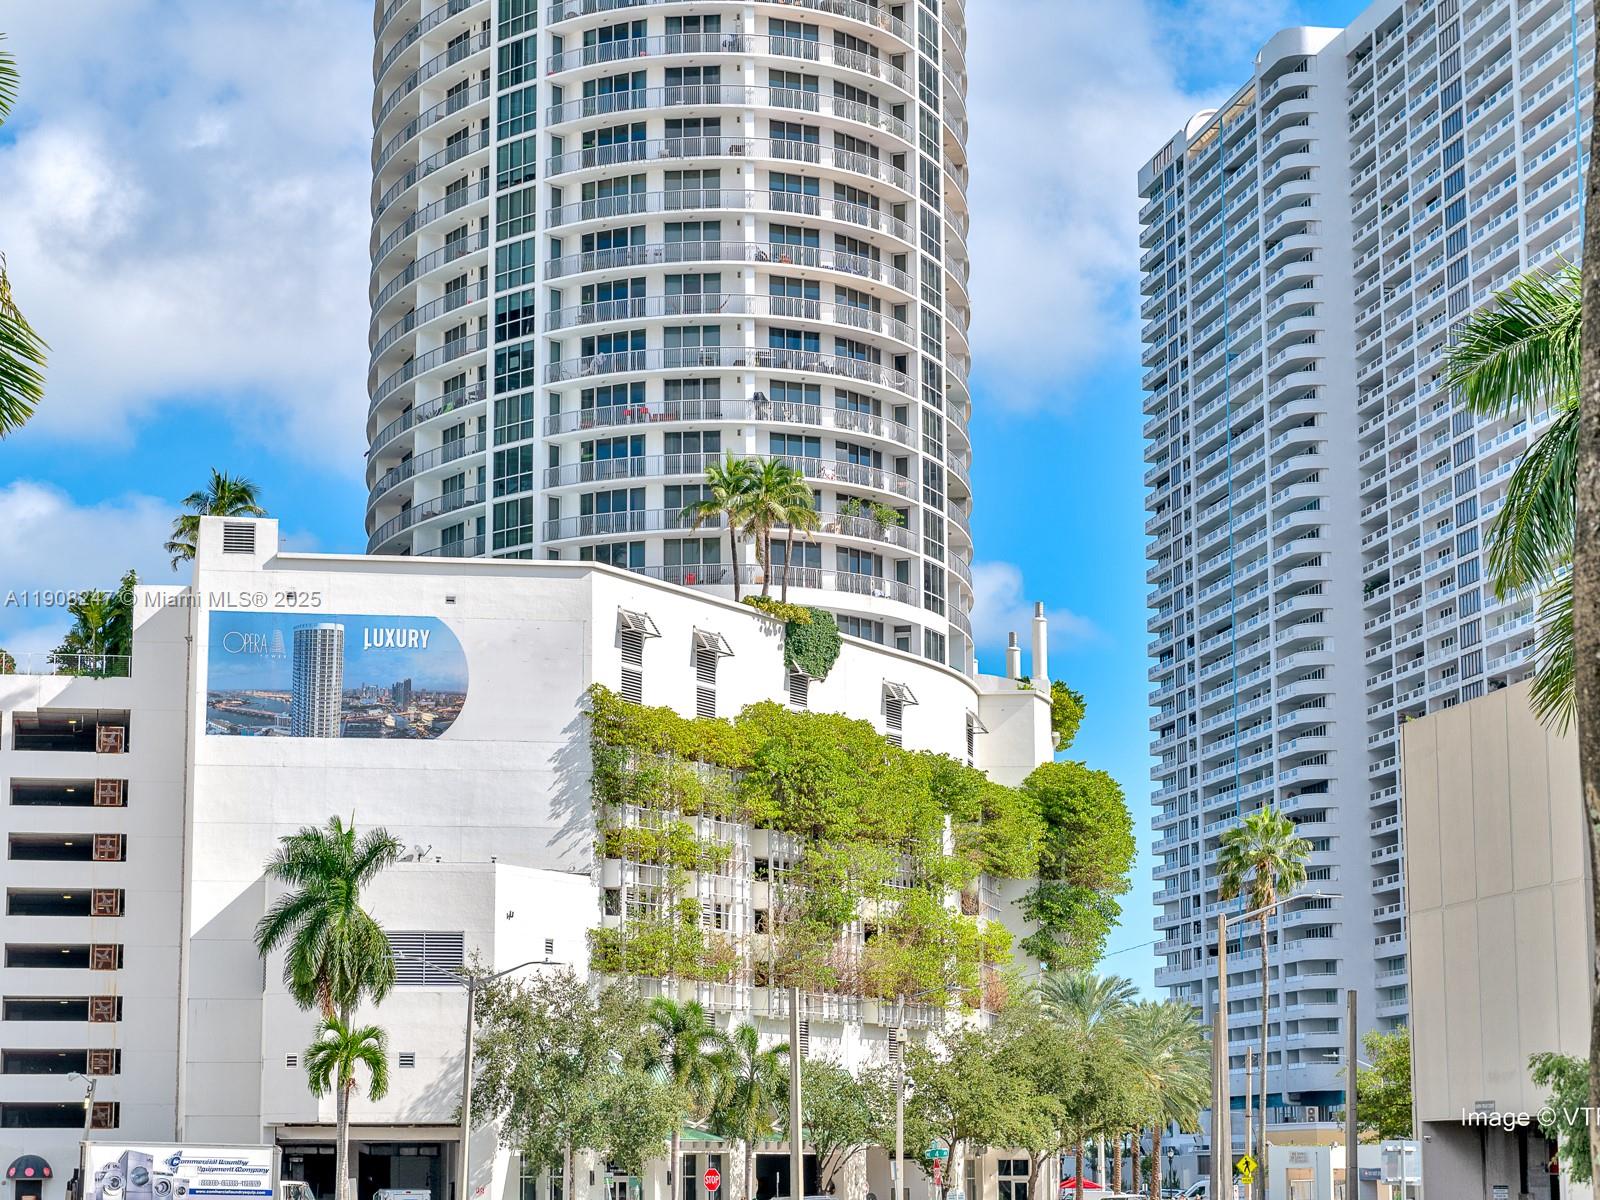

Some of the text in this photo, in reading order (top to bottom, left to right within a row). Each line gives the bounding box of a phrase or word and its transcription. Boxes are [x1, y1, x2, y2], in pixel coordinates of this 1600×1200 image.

[223, 631, 268, 654] OPERA
[363, 627, 431, 650] LUXURY
[705, 1175, 719, 1184] STOP
